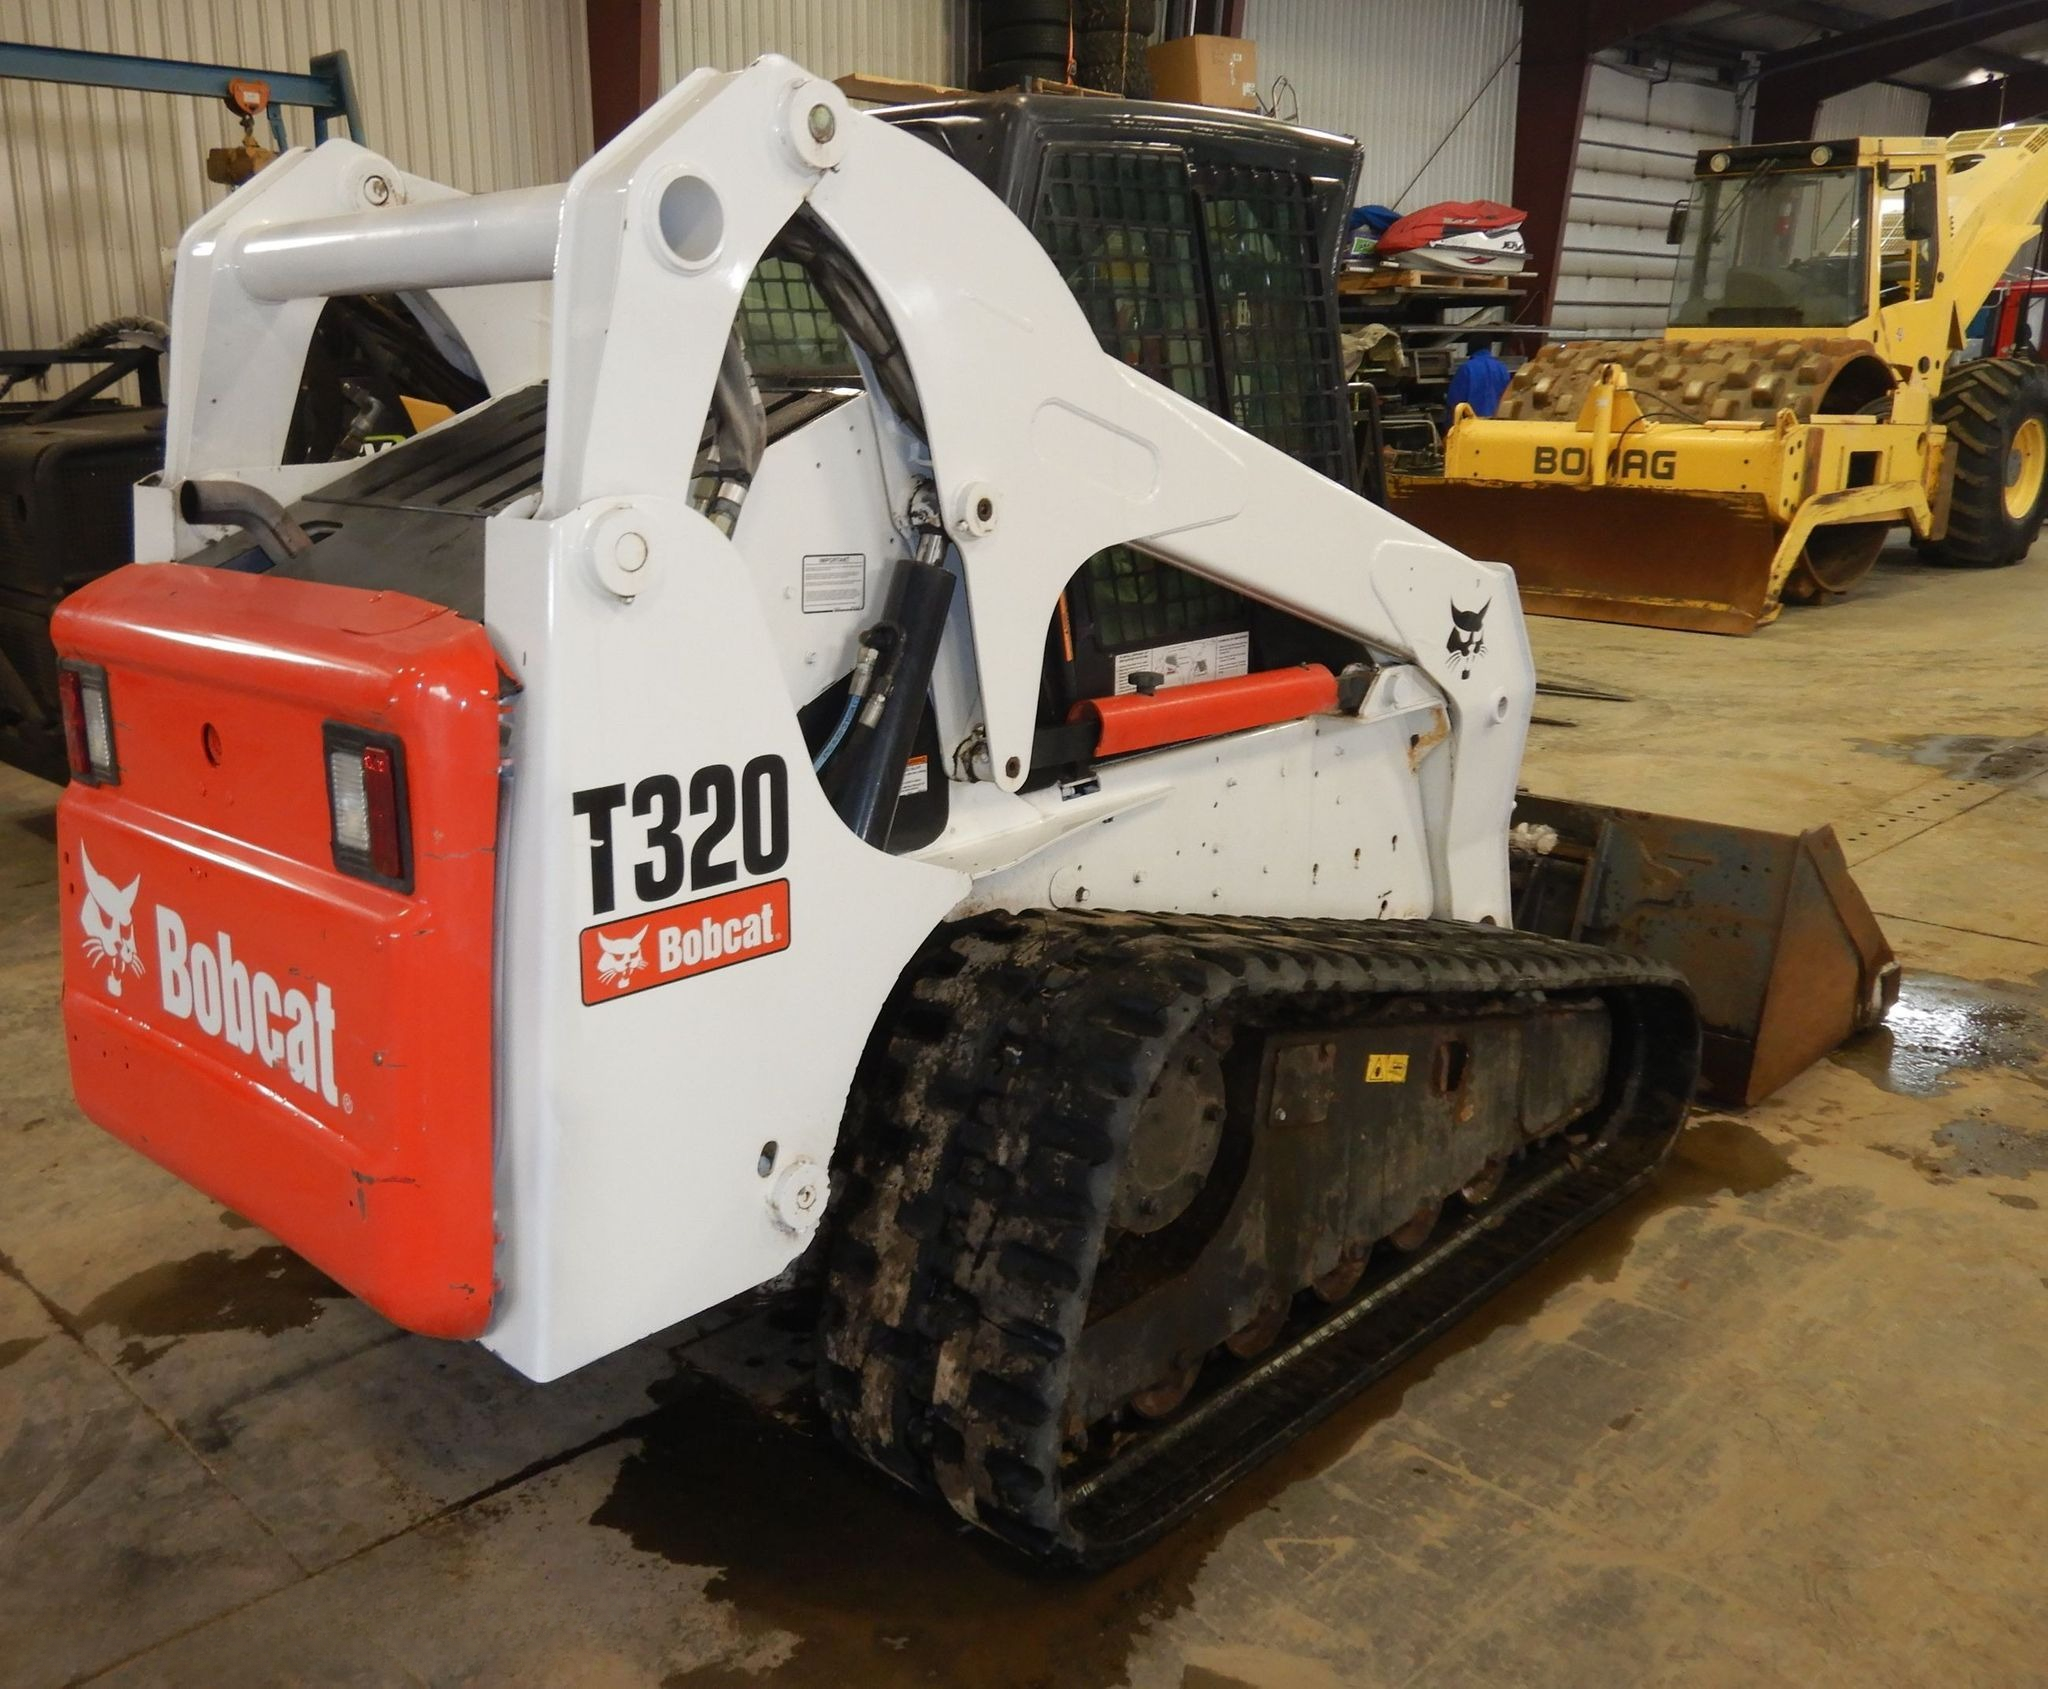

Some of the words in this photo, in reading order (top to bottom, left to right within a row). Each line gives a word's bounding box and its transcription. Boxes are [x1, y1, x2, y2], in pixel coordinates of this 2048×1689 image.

[572, 753, 790, 916] T320
[156, 903, 339, 1107] Bobcat
[659, 903, 774, 974] Bobcat
